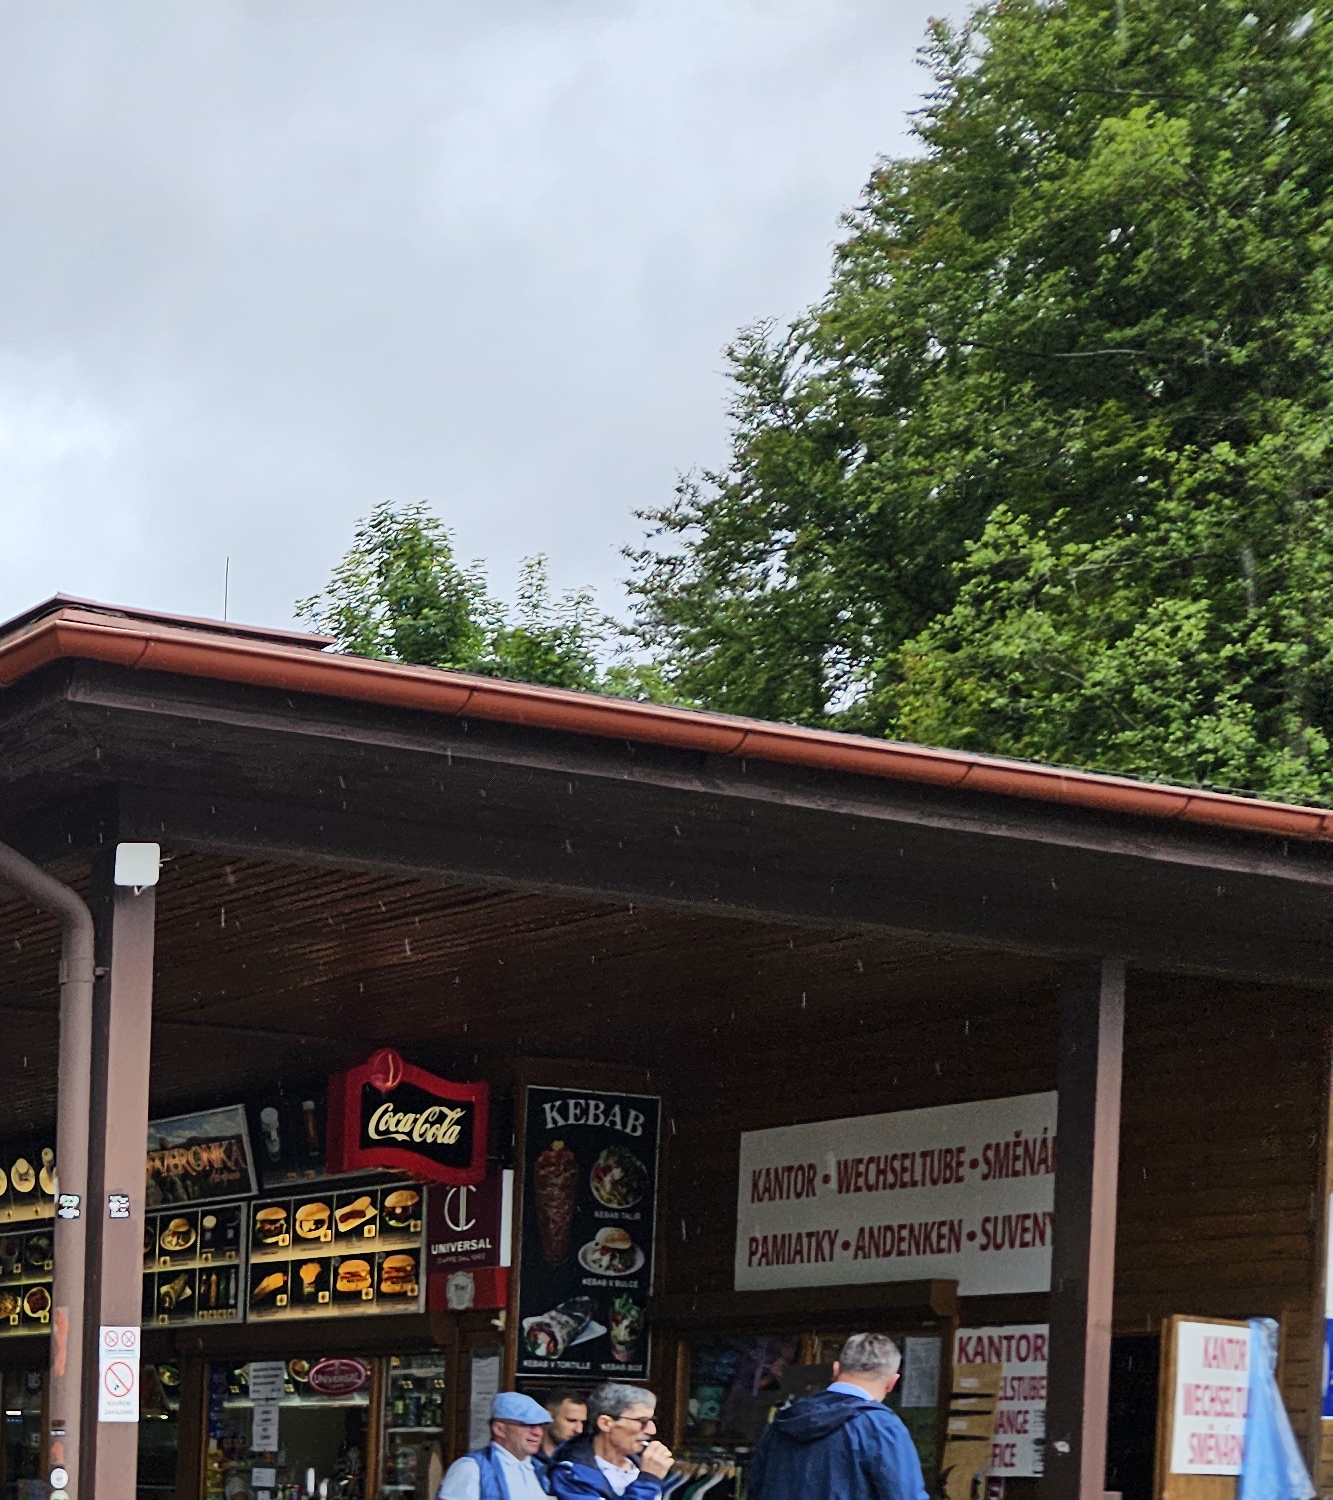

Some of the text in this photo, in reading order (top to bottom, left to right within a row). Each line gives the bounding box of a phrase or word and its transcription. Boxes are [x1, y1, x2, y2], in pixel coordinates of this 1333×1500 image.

[368, 1102, 466, 1145] Coca-Cola
[542, 1100, 646, 1137] KEBAB
[750, 1127, 1057, 1203] KANTOR WECHSELTUBE SMĚNÁ
[431, 1237, 493, 1255] UNIVERSAL
[747, 1211, 1056, 1267] PAMIATKY ANDENKEN SUVEN
[958, 1334, 1047, 1364] KANTOR
[993, 1409, 1029, 1434] ANGE
[991, 1443, 1017, 1468] FICE
